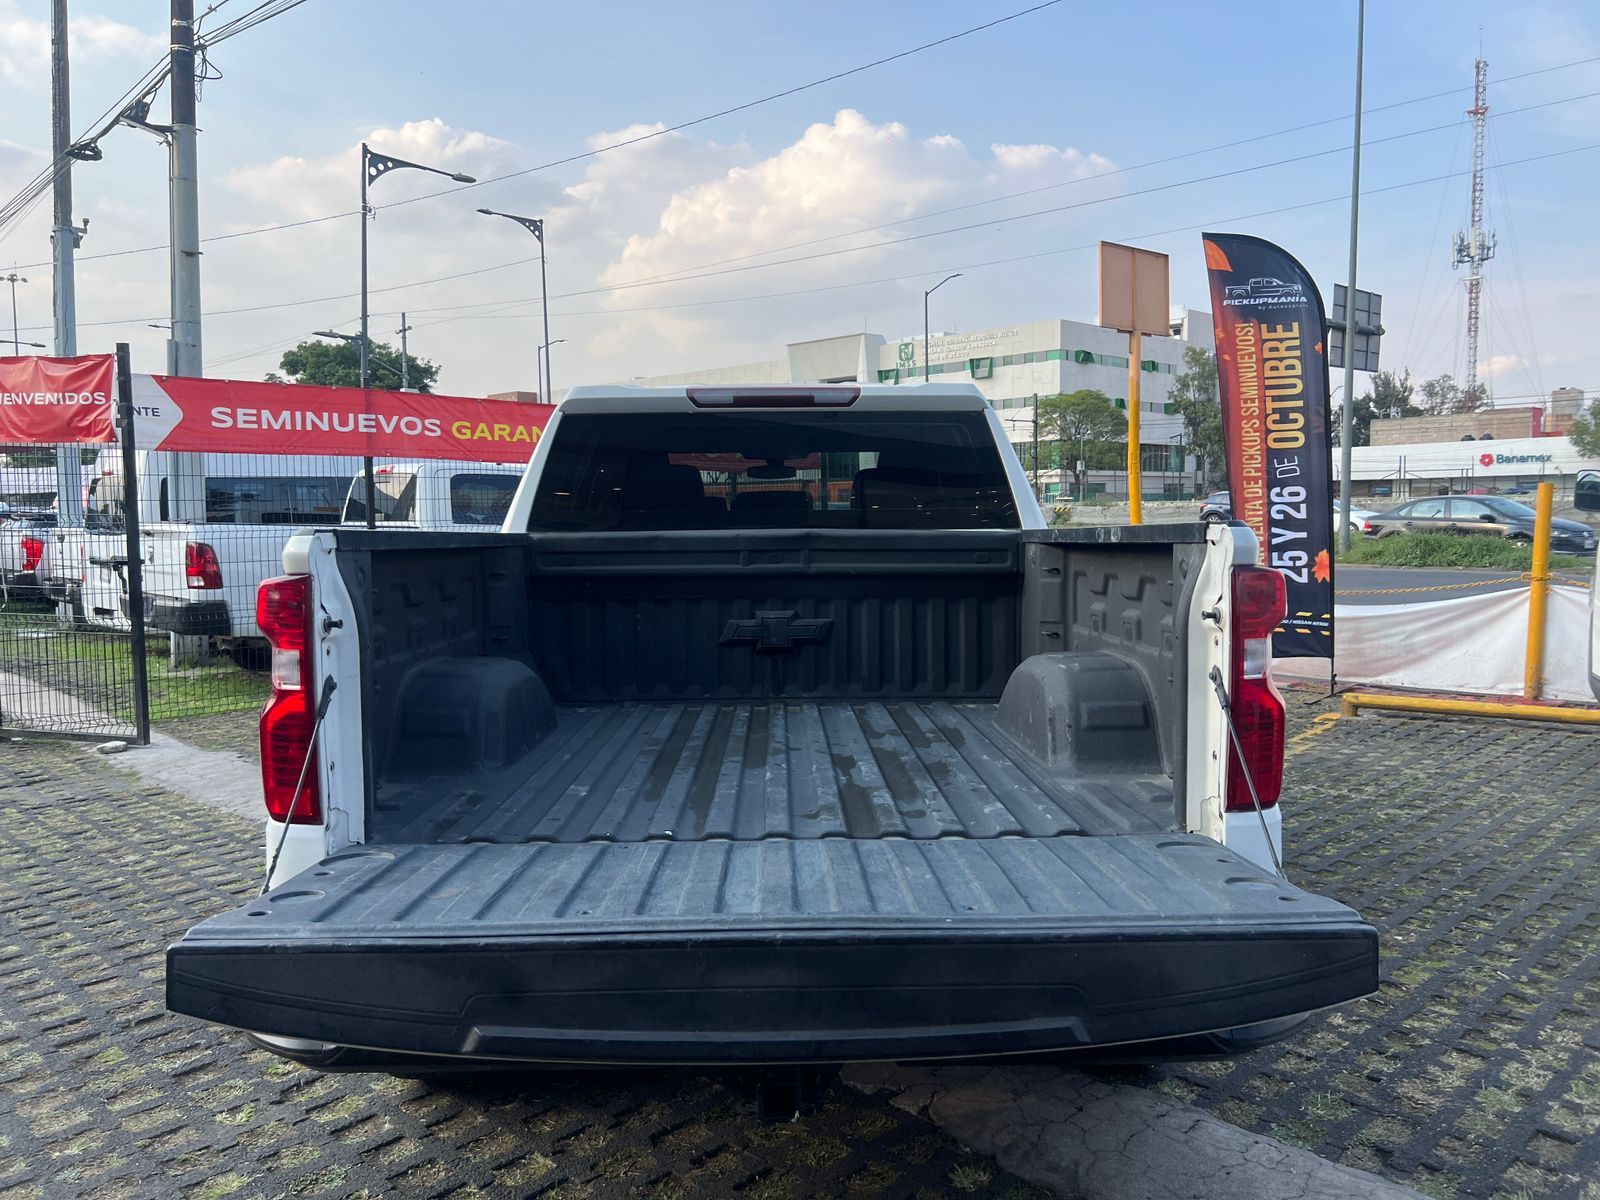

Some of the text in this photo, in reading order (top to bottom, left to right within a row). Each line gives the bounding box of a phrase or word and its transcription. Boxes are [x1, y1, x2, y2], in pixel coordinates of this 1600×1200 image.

[1223, 294, 1307, 306] PICKUPMANÍA
[897, 360, 916, 368] IMSS
[1235, 322, 1259, 416] SEMINUEVOS!
[211, 407, 441, 437] SEMINUEVOS
[1242, 420, 1262, 477] PICKUPS
[1261, 321, 1308, 584] 25 Y 26 DE OCTUBRE
[1496, 454, 1552, 464] Banamex
[1243, 480, 1262, 498] DE
